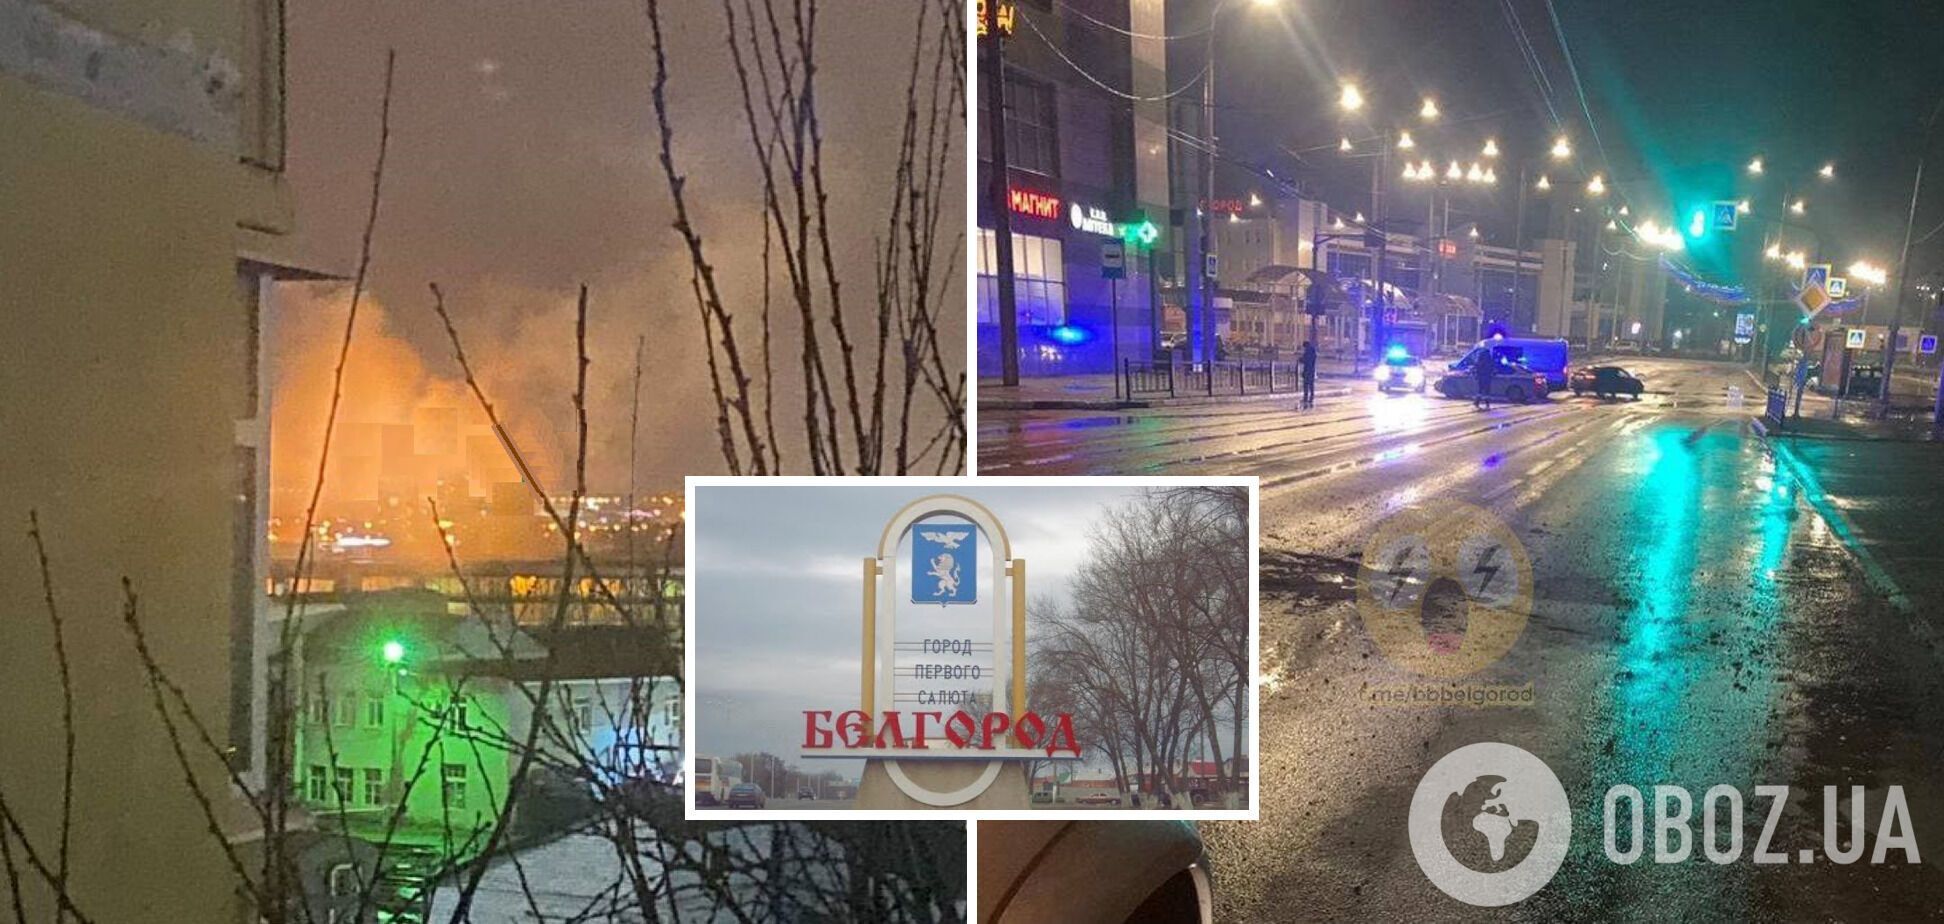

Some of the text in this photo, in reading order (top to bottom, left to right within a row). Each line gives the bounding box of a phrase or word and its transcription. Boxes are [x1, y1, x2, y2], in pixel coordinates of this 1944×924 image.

[1011, 190, 1059, 219] МАГНИТ
[923, 639, 972, 656] ГОРОД
[914, 664, 981, 680] ПЕРВОГО
[917, 690, 978, 705] САЛЮТА
[801, 710, 1082, 758] БЕЛГОРОД
